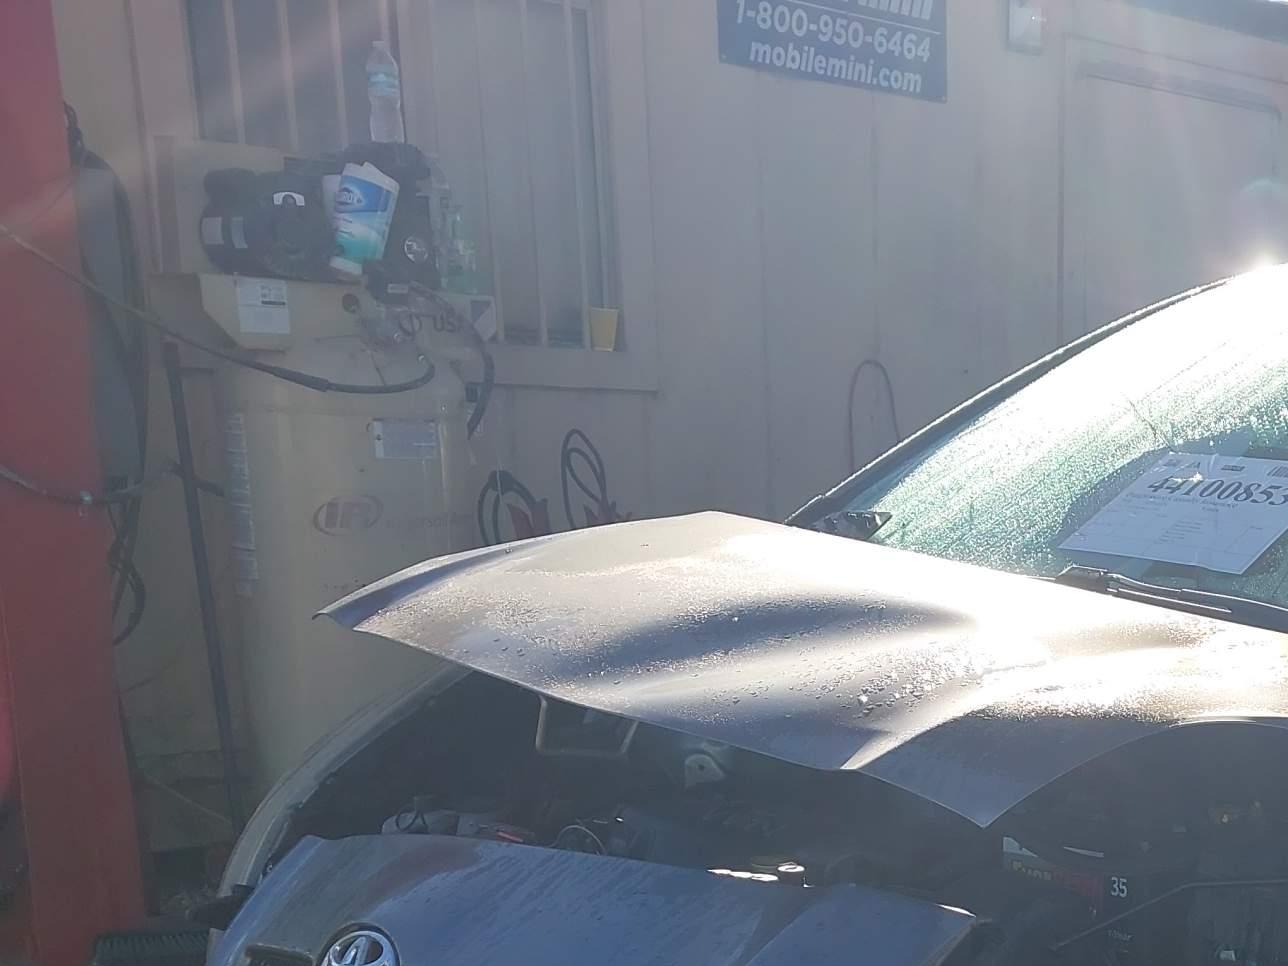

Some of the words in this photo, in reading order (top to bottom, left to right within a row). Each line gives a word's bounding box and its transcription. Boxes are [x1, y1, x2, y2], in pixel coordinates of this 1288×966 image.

[735, 0, 931, 62] 1-800-950-6464
[750, 41, 922, 93] mobilemini.com
[1111, 876, 1127, 898] 35
